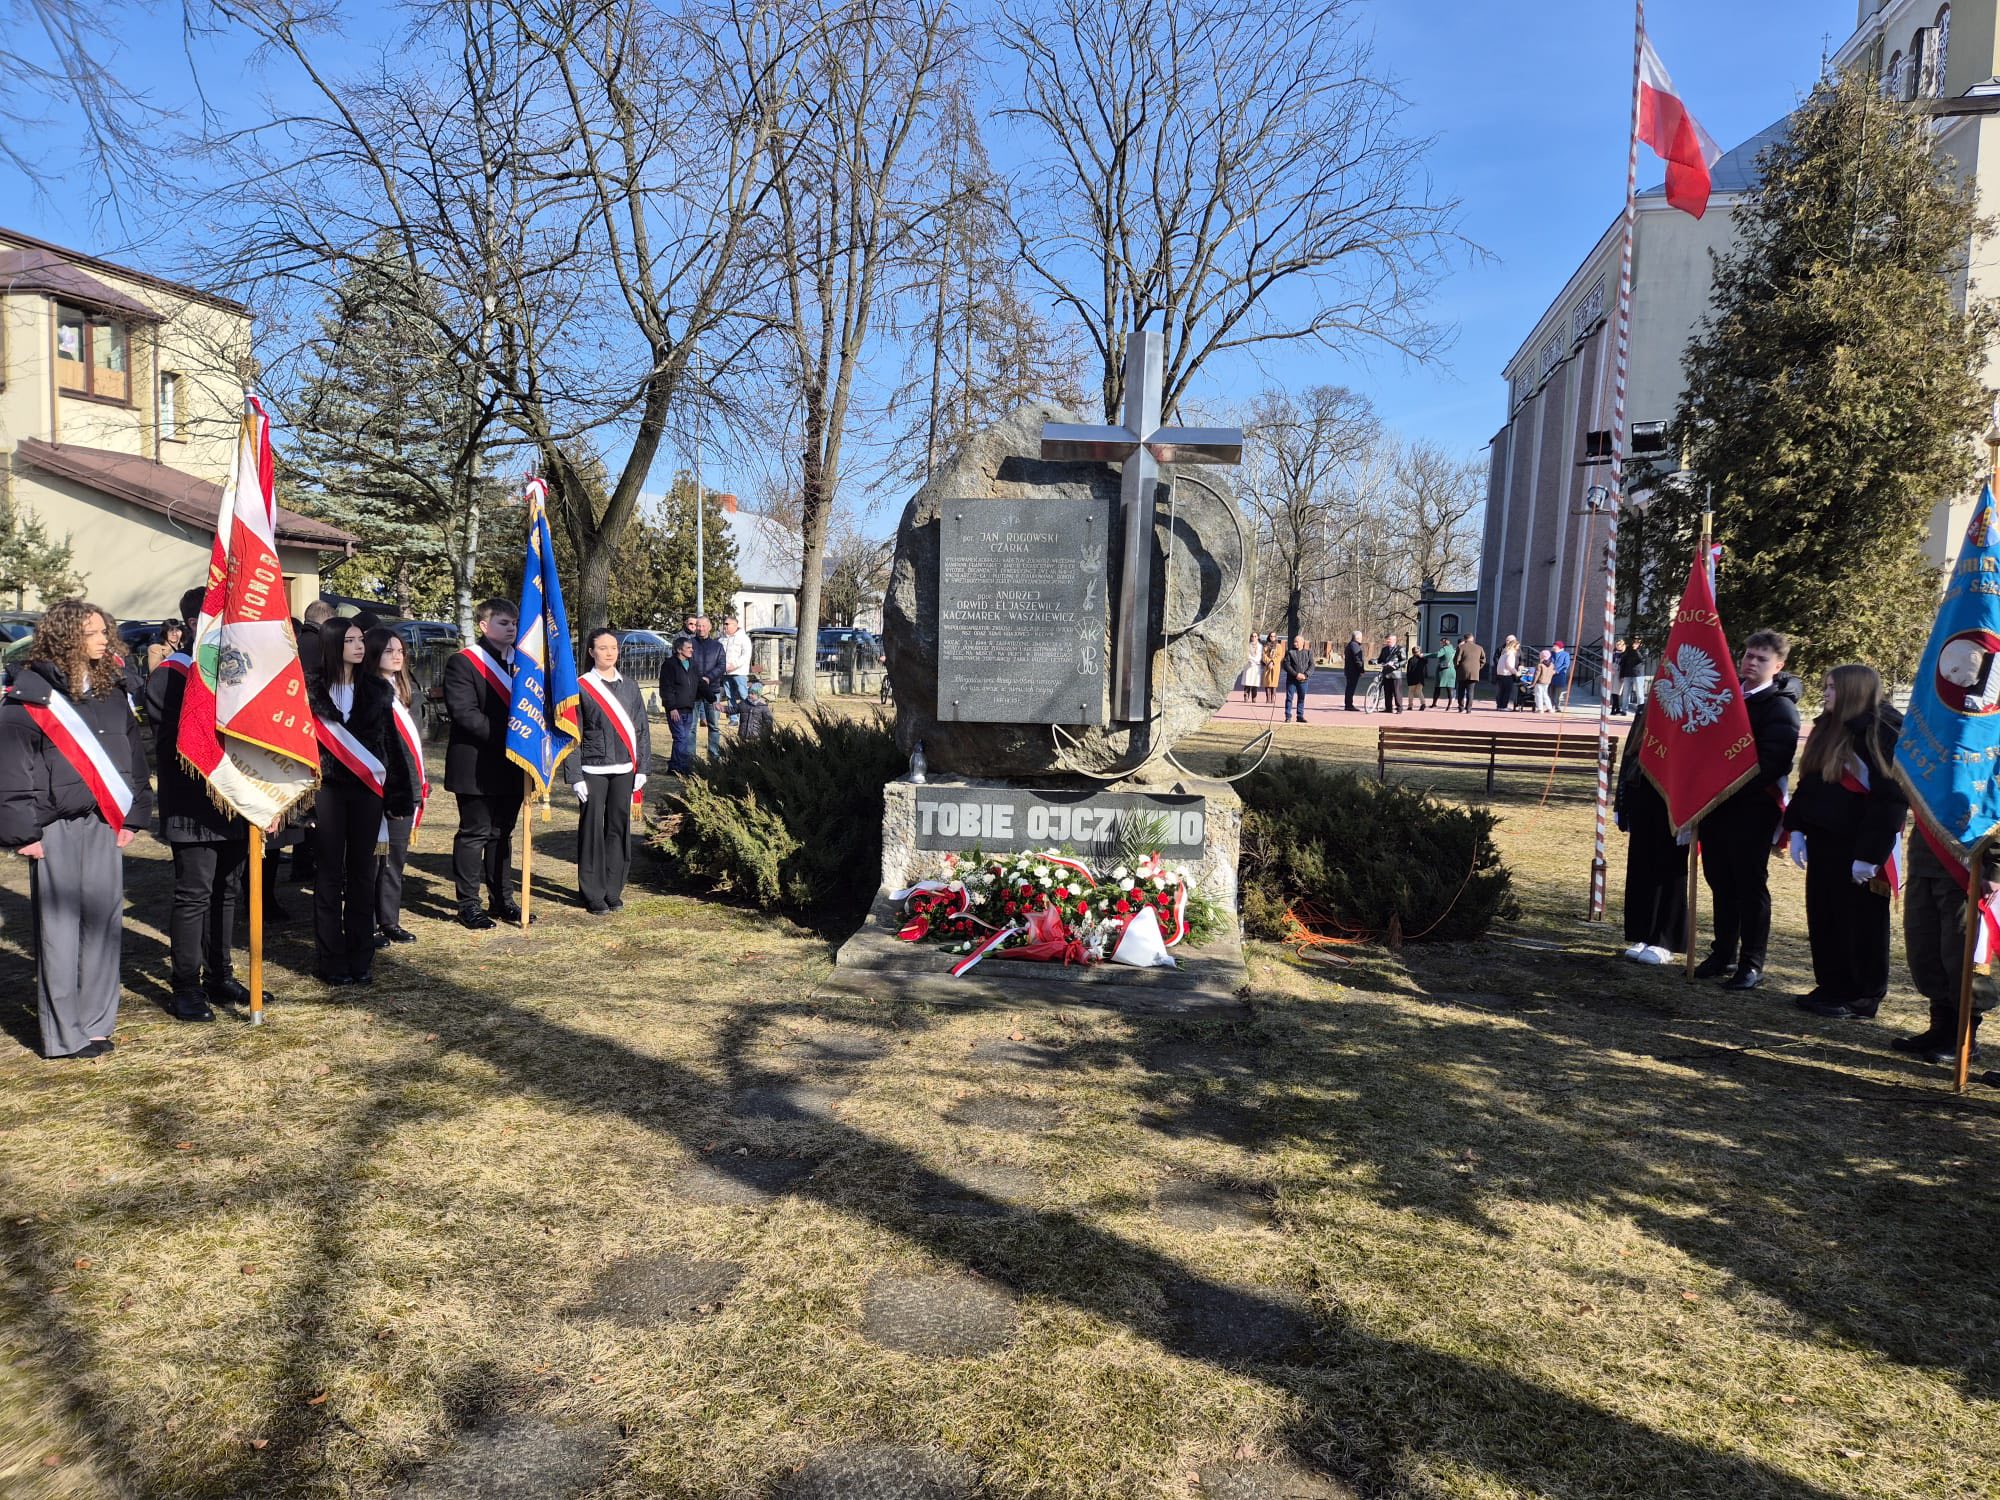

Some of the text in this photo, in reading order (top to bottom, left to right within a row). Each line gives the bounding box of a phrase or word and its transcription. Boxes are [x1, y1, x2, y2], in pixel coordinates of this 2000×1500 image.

[980, 532, 999, 542] JAN
[1006, 532, 1058, 543] ROGOWSKI
[990, 543, 1029, 553] CZARKA
[238, 552, 279, 620] HONOR
[996, 590, 1040, 600] ANDRZEJ
[956, 600, 988, 610] ORWID
[943, 610, 1000, 621] KACZMAREK
[1008, 611, 1075, 622] WASZKIEWICZ
[1678, 609, 1722, 630] OJCZ
[508, 716, 532, 739] 2012
[1724, 732, 1755, 761] 2021
[917, 801, 1204, 846] TOBIE OJCZNO
